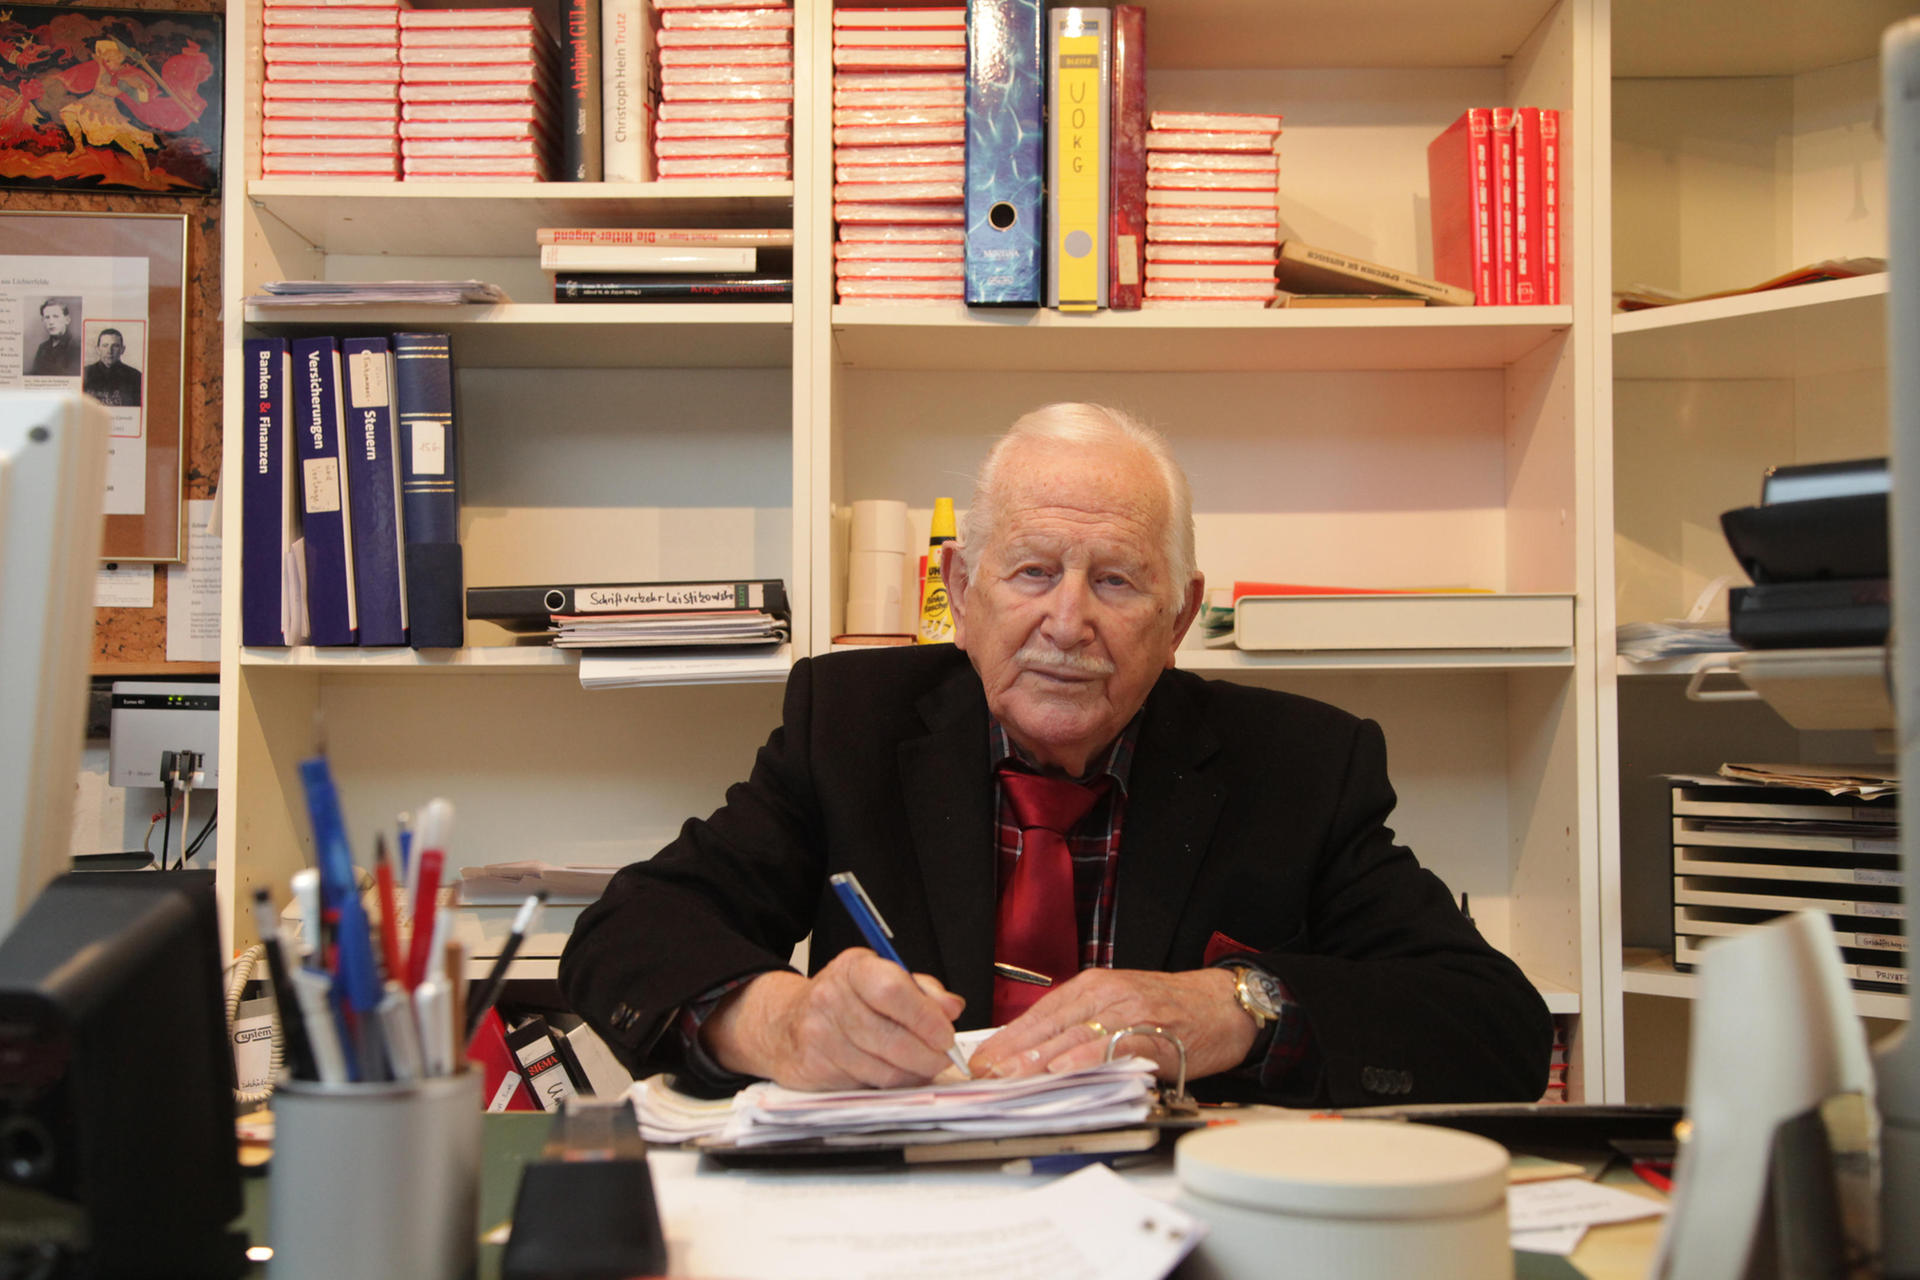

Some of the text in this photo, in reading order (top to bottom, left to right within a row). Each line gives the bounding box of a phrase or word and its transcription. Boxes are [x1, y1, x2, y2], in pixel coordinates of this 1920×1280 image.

[615, 12, 629, 143] Christoph Hein Trutz
[554, 230, 656, 243] Die Hitler-Jugend
[259, 350, 271, 474] Banken & Finanzen
[308, 350, 324, 450] Versicherungen
[364, 410, 377, 461] Steuern
[528, 1055, 558, 1076] SIGMA
